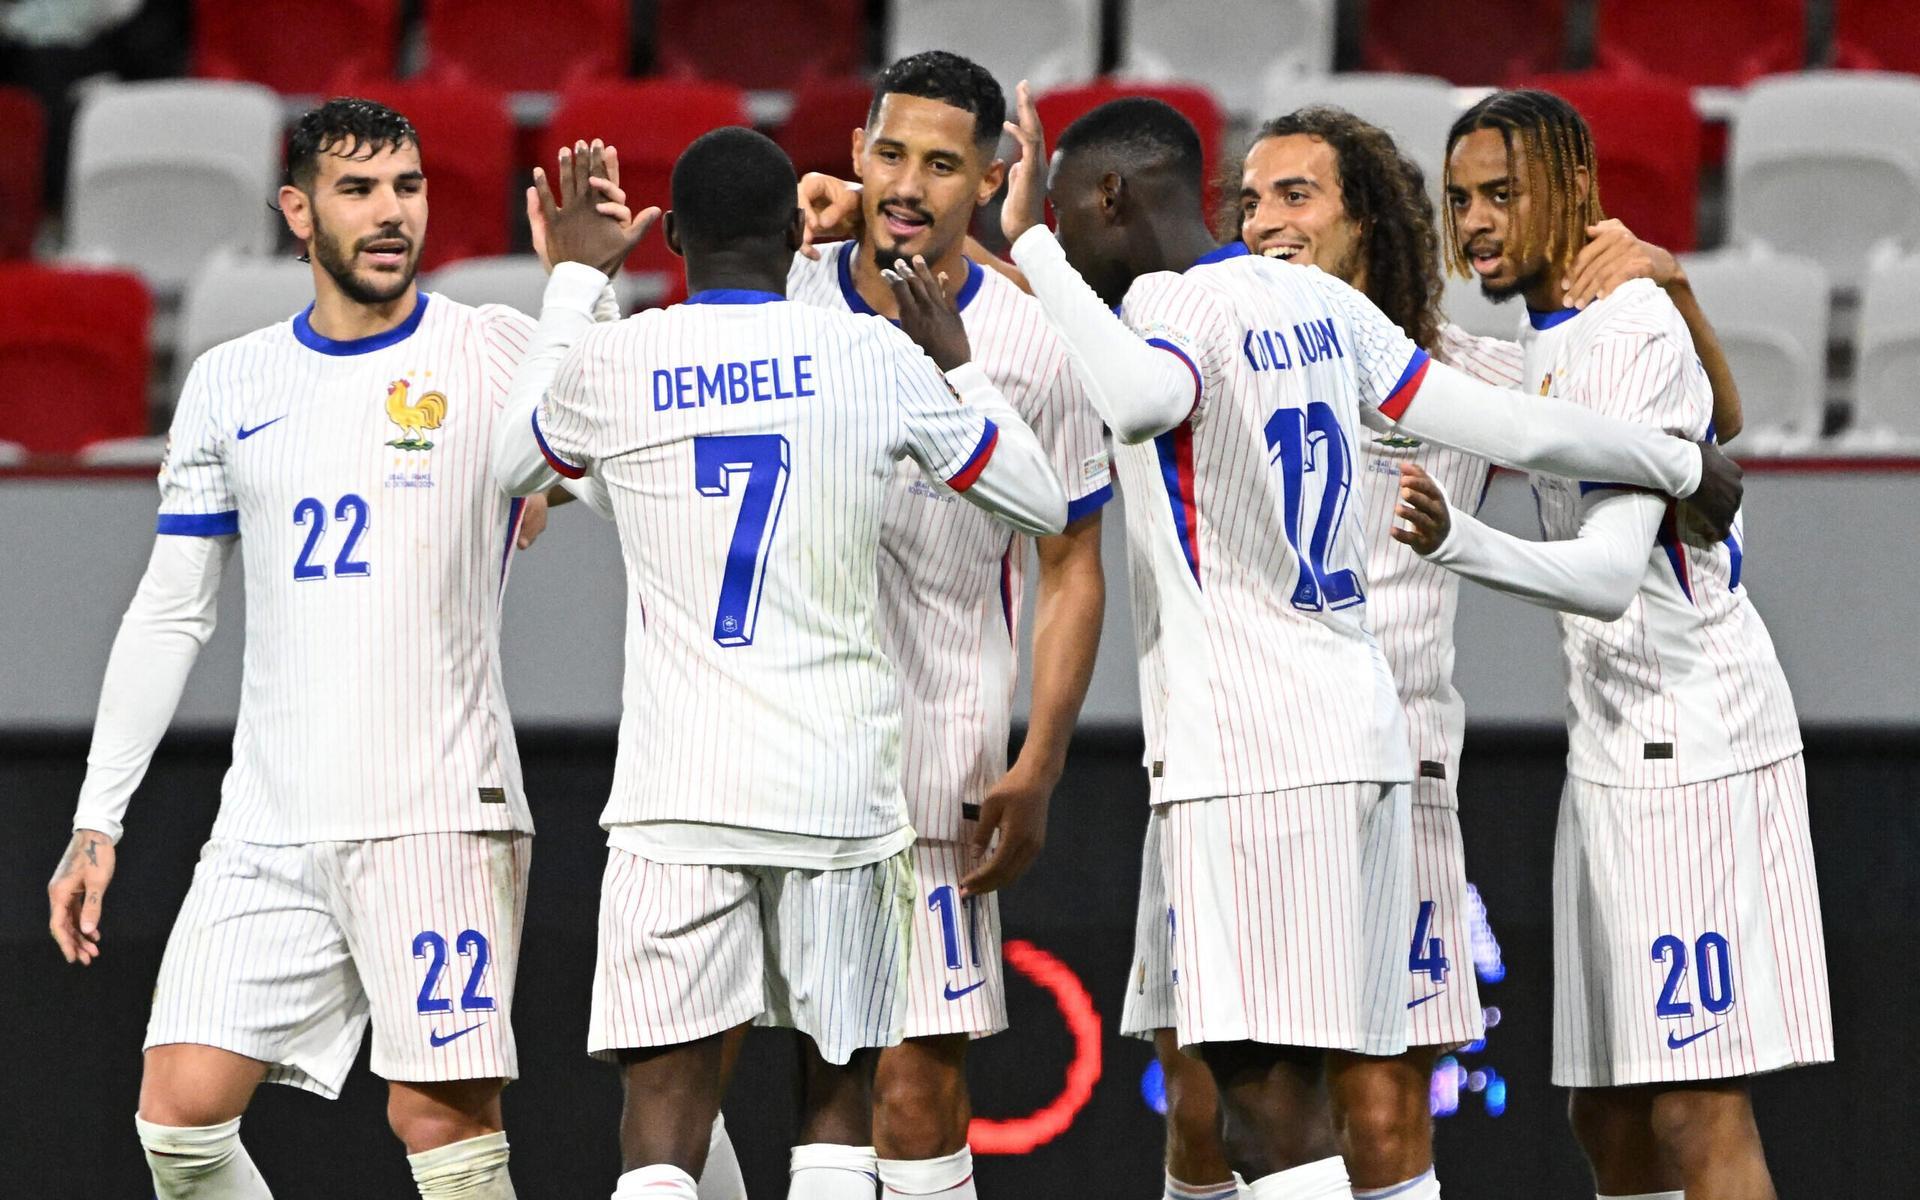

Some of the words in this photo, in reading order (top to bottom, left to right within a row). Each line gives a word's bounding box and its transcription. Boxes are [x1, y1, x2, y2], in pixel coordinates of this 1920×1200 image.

[653, 355, 816, 412] DEMBELE
[293, 493, 371, 582] 22
[693, 433, 791, 648] 7
[1263, 401, 1367, 612] 12
[412, 929, 496, 1016] 22
[1651, 931, 1736, 1020] 20
